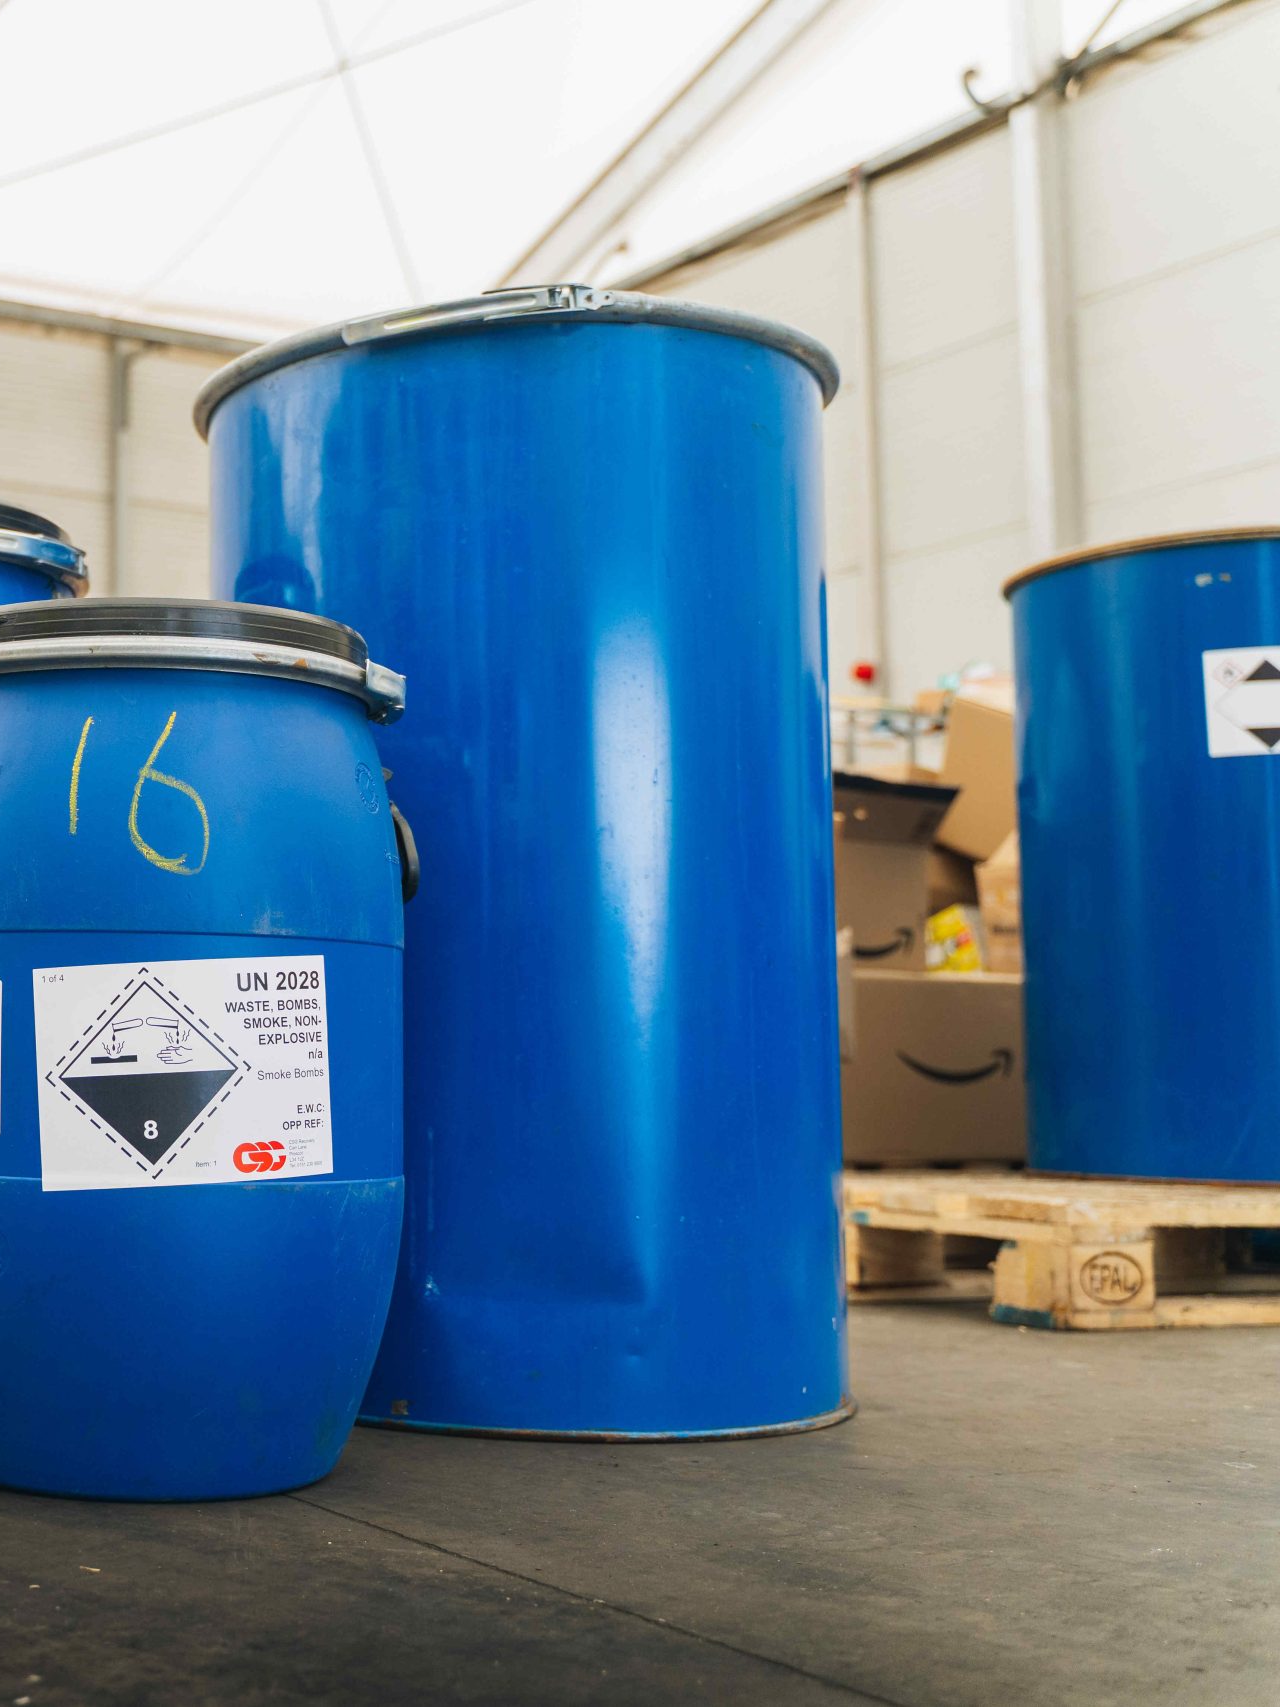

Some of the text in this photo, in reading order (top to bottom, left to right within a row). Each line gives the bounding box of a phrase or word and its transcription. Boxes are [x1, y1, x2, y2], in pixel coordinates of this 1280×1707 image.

[69, 711, 210, 876] 16
[48, 974, 57, 983] of
[59, 974, 64, 982] 4
[236, 970, 320, 992] UN 2028
[225, 998, 321, 1013] WASTE, BOMBS,
[243, 1015, 322, 1029] SMOKE, NON-
[258, 1031, 322, 1045] EXPLOSIVE
[308, 1047, 323, 1060] n/a
[257, 1068, 324, 1081] Smoke Bombs
[297, 1103, 325, 1114] E.W.C:
[143, 1120, 159, 1139] 8
[282, 1118, 324, 1130] OPP REF:
[1088, 1263, 1138, 1294] EPAL
